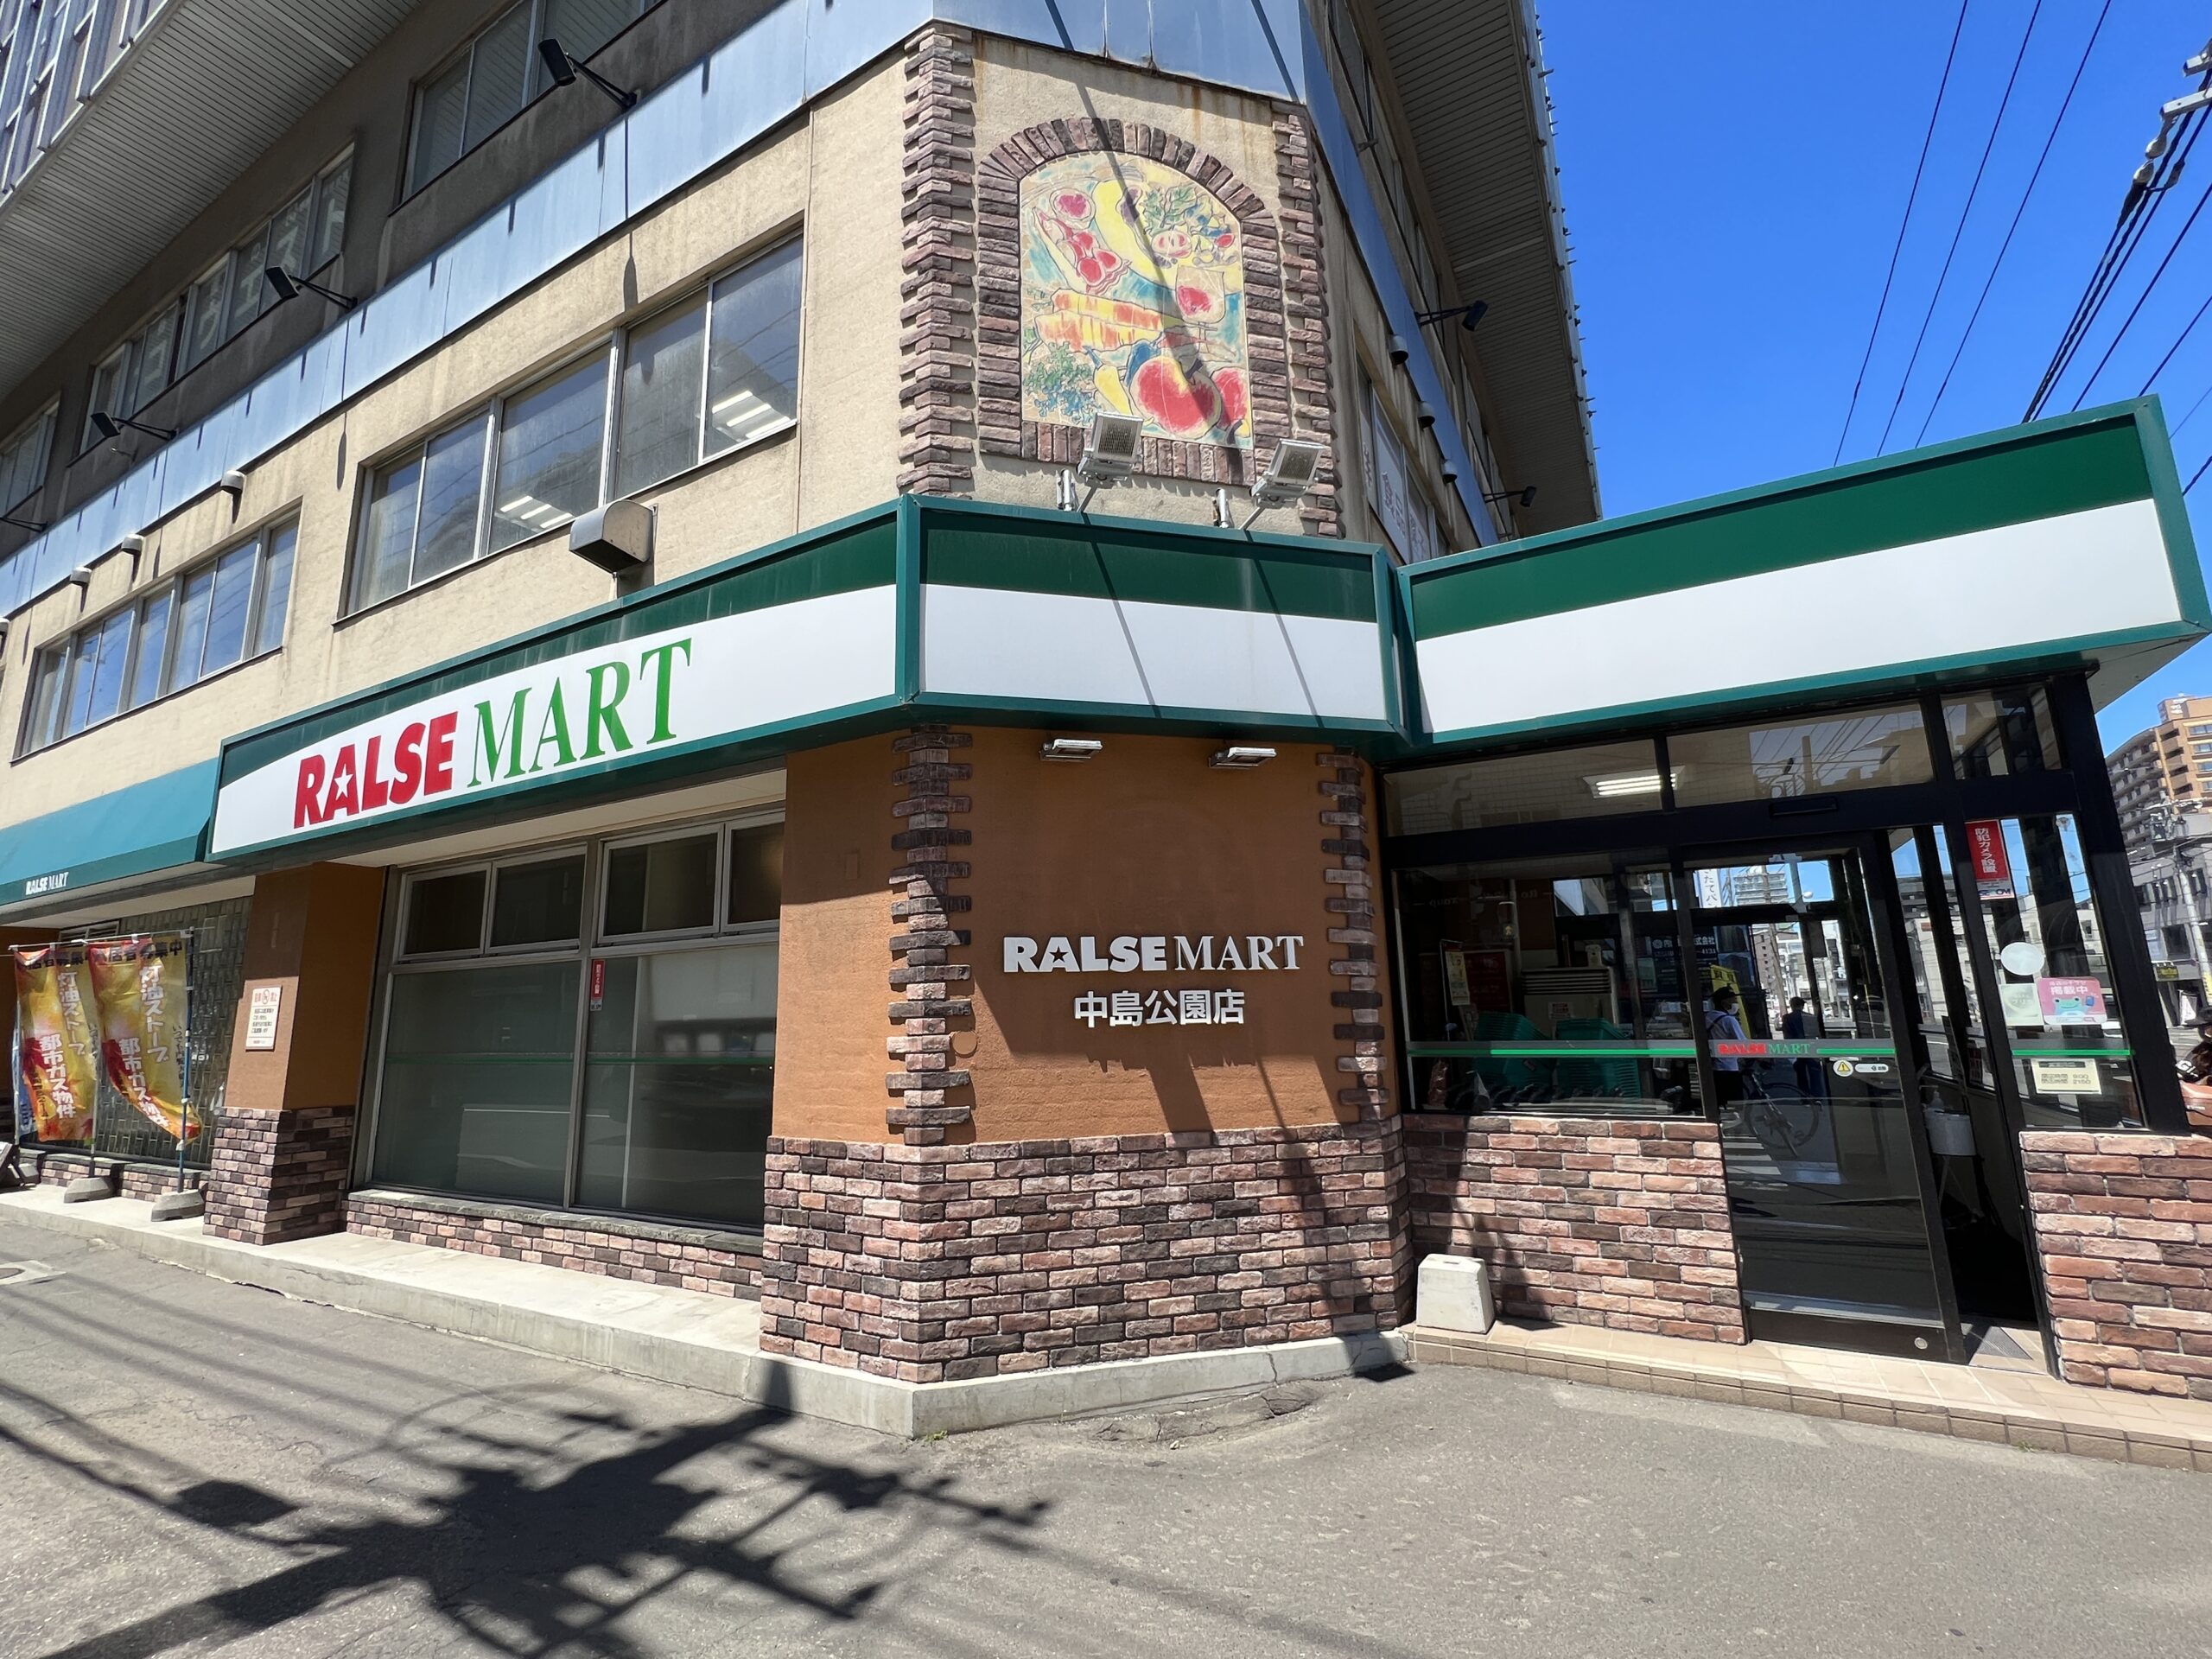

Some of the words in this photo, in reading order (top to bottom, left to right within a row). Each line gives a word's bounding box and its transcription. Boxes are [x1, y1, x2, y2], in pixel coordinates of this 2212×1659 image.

[294, 710, 459, 830] RALSE
[467, 638, 693, 788] MART
[1002, 935, 1167, 973] RALSE
[1173, 935, 1305, 971] MART
[139, 964, 170, 1064] 灯油ストーブ
[1074, 988, 1246, 1028] 中島公園店
[39, 1033, 77, 1119] 都市ガス物件
[1767, 1042, 1811, 1055] MART
